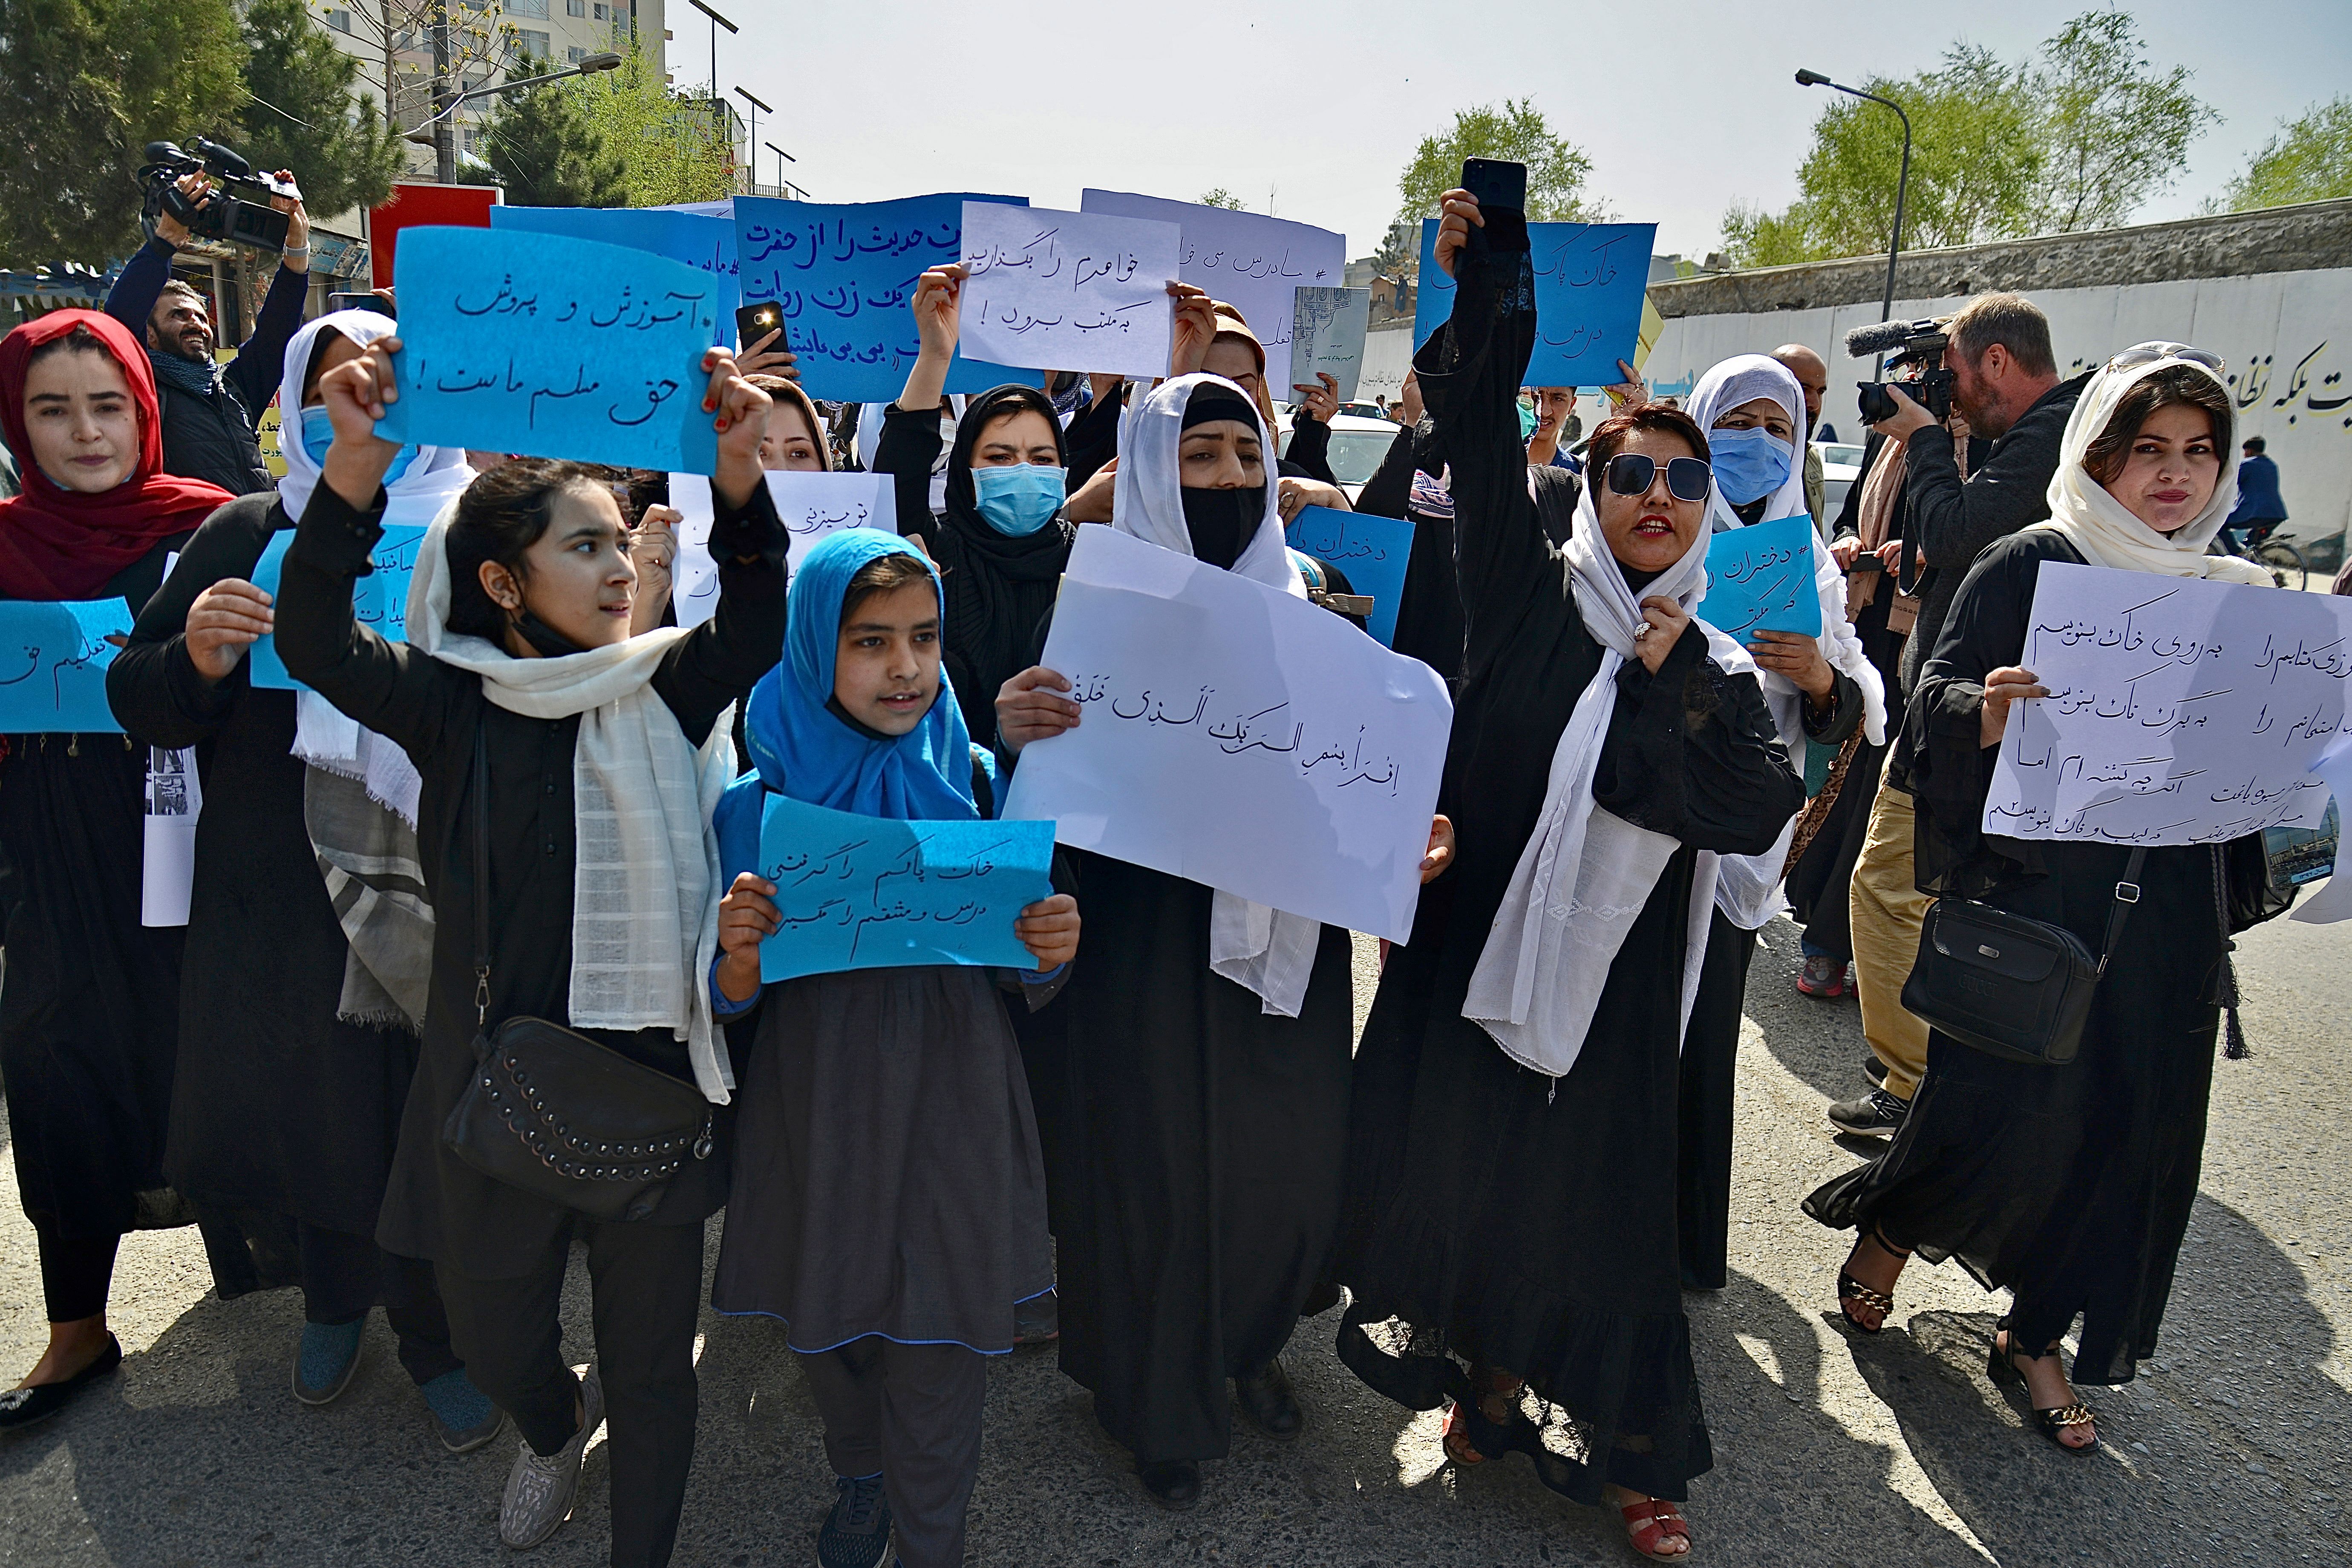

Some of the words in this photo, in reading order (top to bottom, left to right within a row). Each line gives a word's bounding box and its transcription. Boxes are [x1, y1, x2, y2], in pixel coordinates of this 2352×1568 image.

[793, 222, 824, 269] از
[834, 218, 855, 261] را
[1042, 237, 1061, 277] را
[1075, 254, 1139, 292] خواهرم
[556, 301, 577, 322] و
[811, 280, 859, 318] زن
[1074, 300, 1152, 333] مکتب
[1543, 324, 1602, 359] درس
[608, 379, 679, 425] حق
[1316, 522, 1386, 560] دختران
[2254, 633, 2274, 668] را
[2252, 703, 2274, 734] را
[2017, 738, 2052, 769] اما
[838, 855, 854, 879] را
[938, 839, 1012, 879] خاک
[837, 905, 854, 925] را
[934, 899, 987, 925] درس
